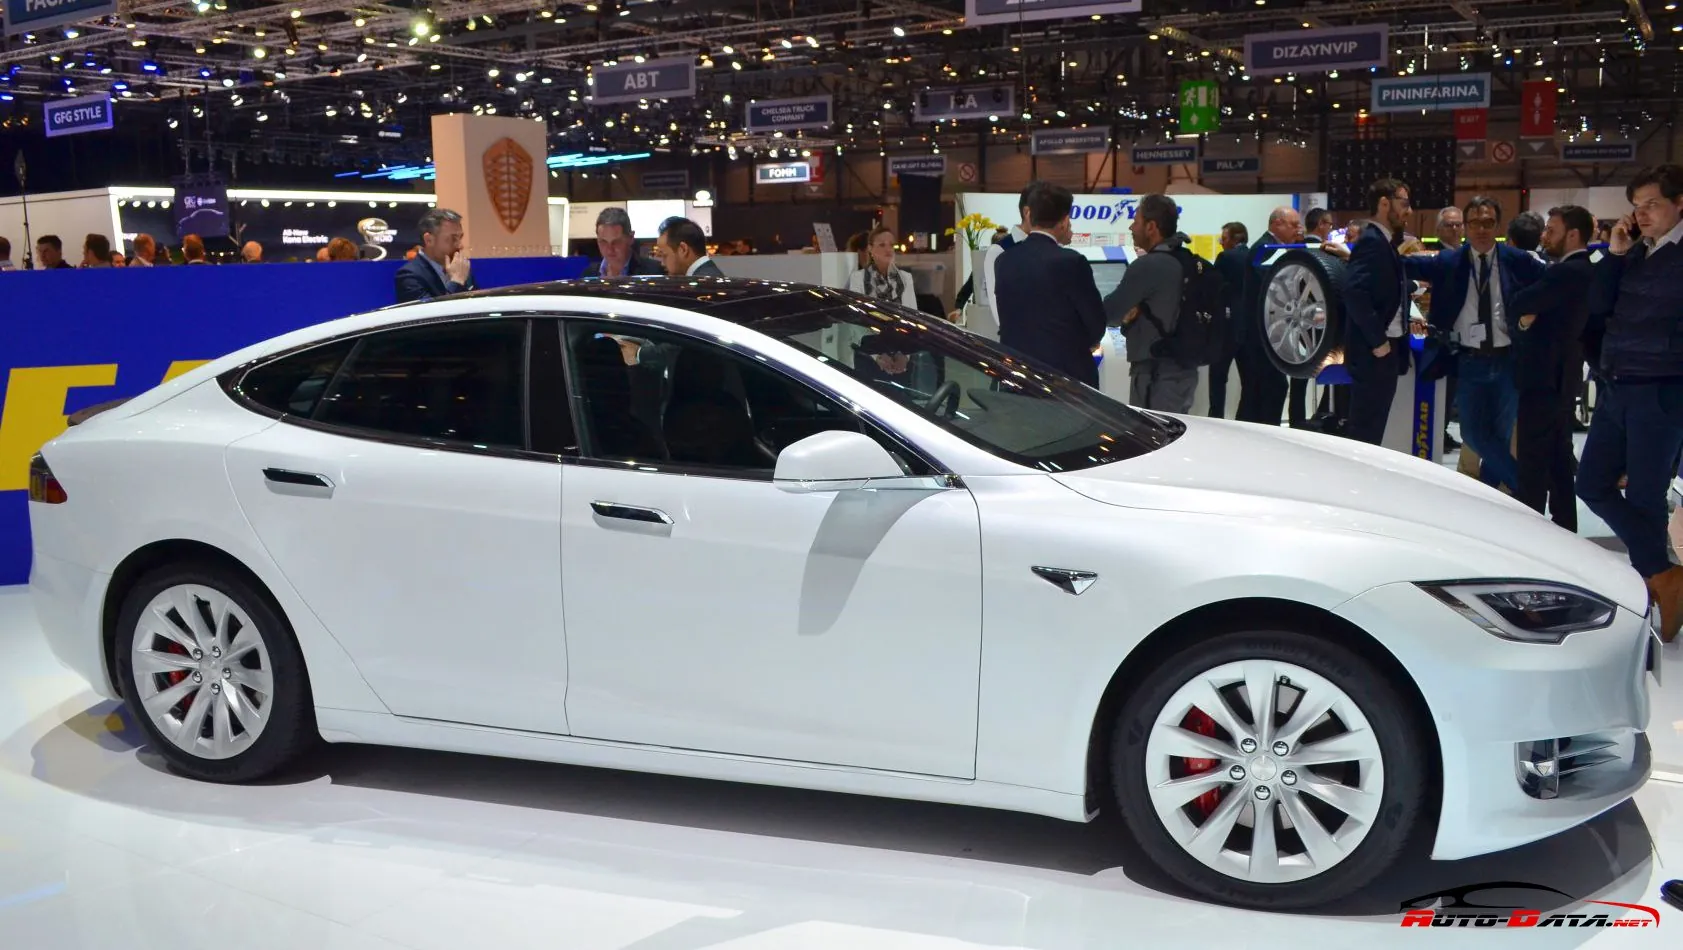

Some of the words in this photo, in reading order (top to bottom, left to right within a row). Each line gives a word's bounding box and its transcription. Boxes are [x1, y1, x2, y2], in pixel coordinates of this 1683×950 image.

[1273, 41, 1358, 60] DIZAYNVIP
[624, 71, 660, 90] ABT
[1382, 85, 1480, 100] PININFARINA
[54, 110, 73, 124] GFG
[73, 105, 102, 121] STYLE
[761, 106, 792, 116] CHELSEA
[792, 104, 816, 113] TRUCK
[771, 113, 805, 122] COMPANY
[1136, 149, 1191, 160] HENNESSEY
[1216, 160, 1245, 170] PAL-V
[768, 167, 797, 178] FOMM
